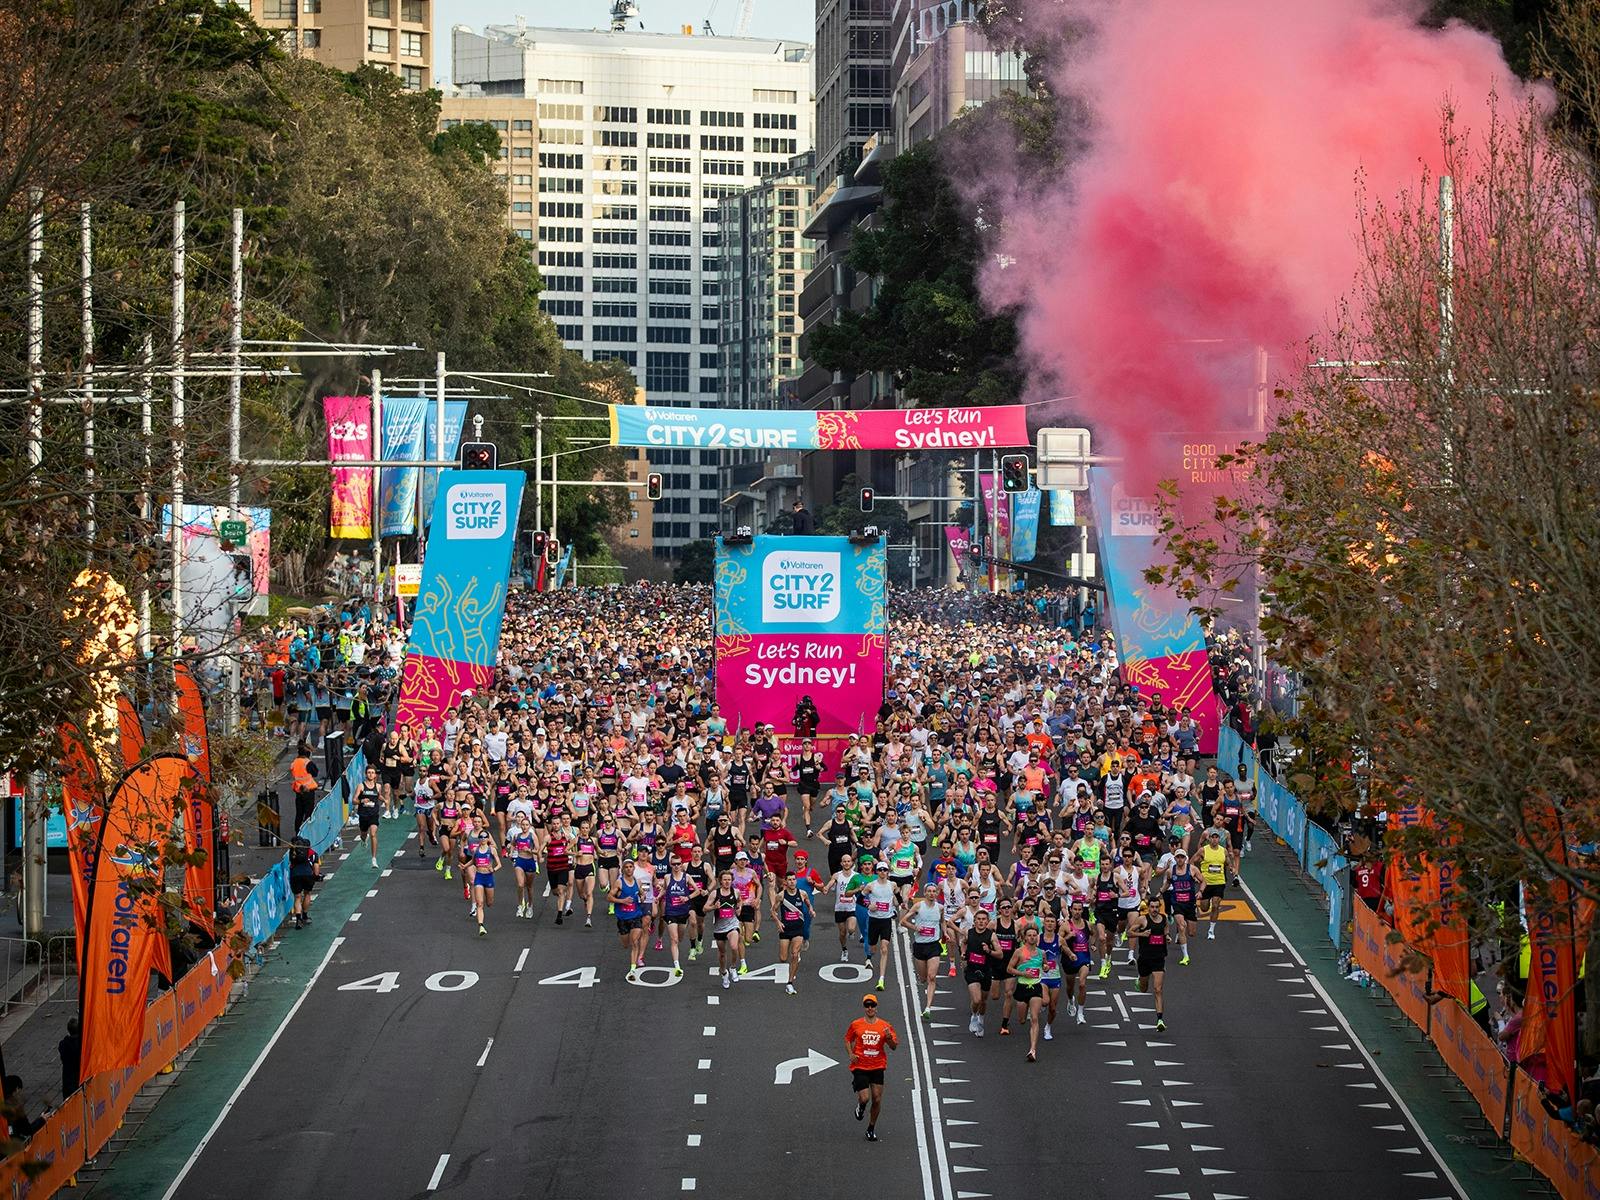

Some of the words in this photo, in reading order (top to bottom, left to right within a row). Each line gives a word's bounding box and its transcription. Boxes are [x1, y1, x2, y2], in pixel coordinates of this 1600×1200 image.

[656, 409, 698, 422] Voltaren
[904, 408, 944, 426] Let's
[947, 408, 982, 425] Run
[895, 426, 996, 448] Sydney!
[1183, 444, 1216, 456] GOOD
[1191, 471, 1250, 483] RUNNRS
[468, 490, 494, 499] Voltaren
[455, 516, 499, 529] SURF
[790, 560, 824, 570] Voltaren
[773, 593, 830, 610] SURF
[757, 642, 800, 659] Let's
[804, 642, 843, 659] Run
[744, 663, 856, 689] Sydney!
[1361, 874, 1369, 888] 9
